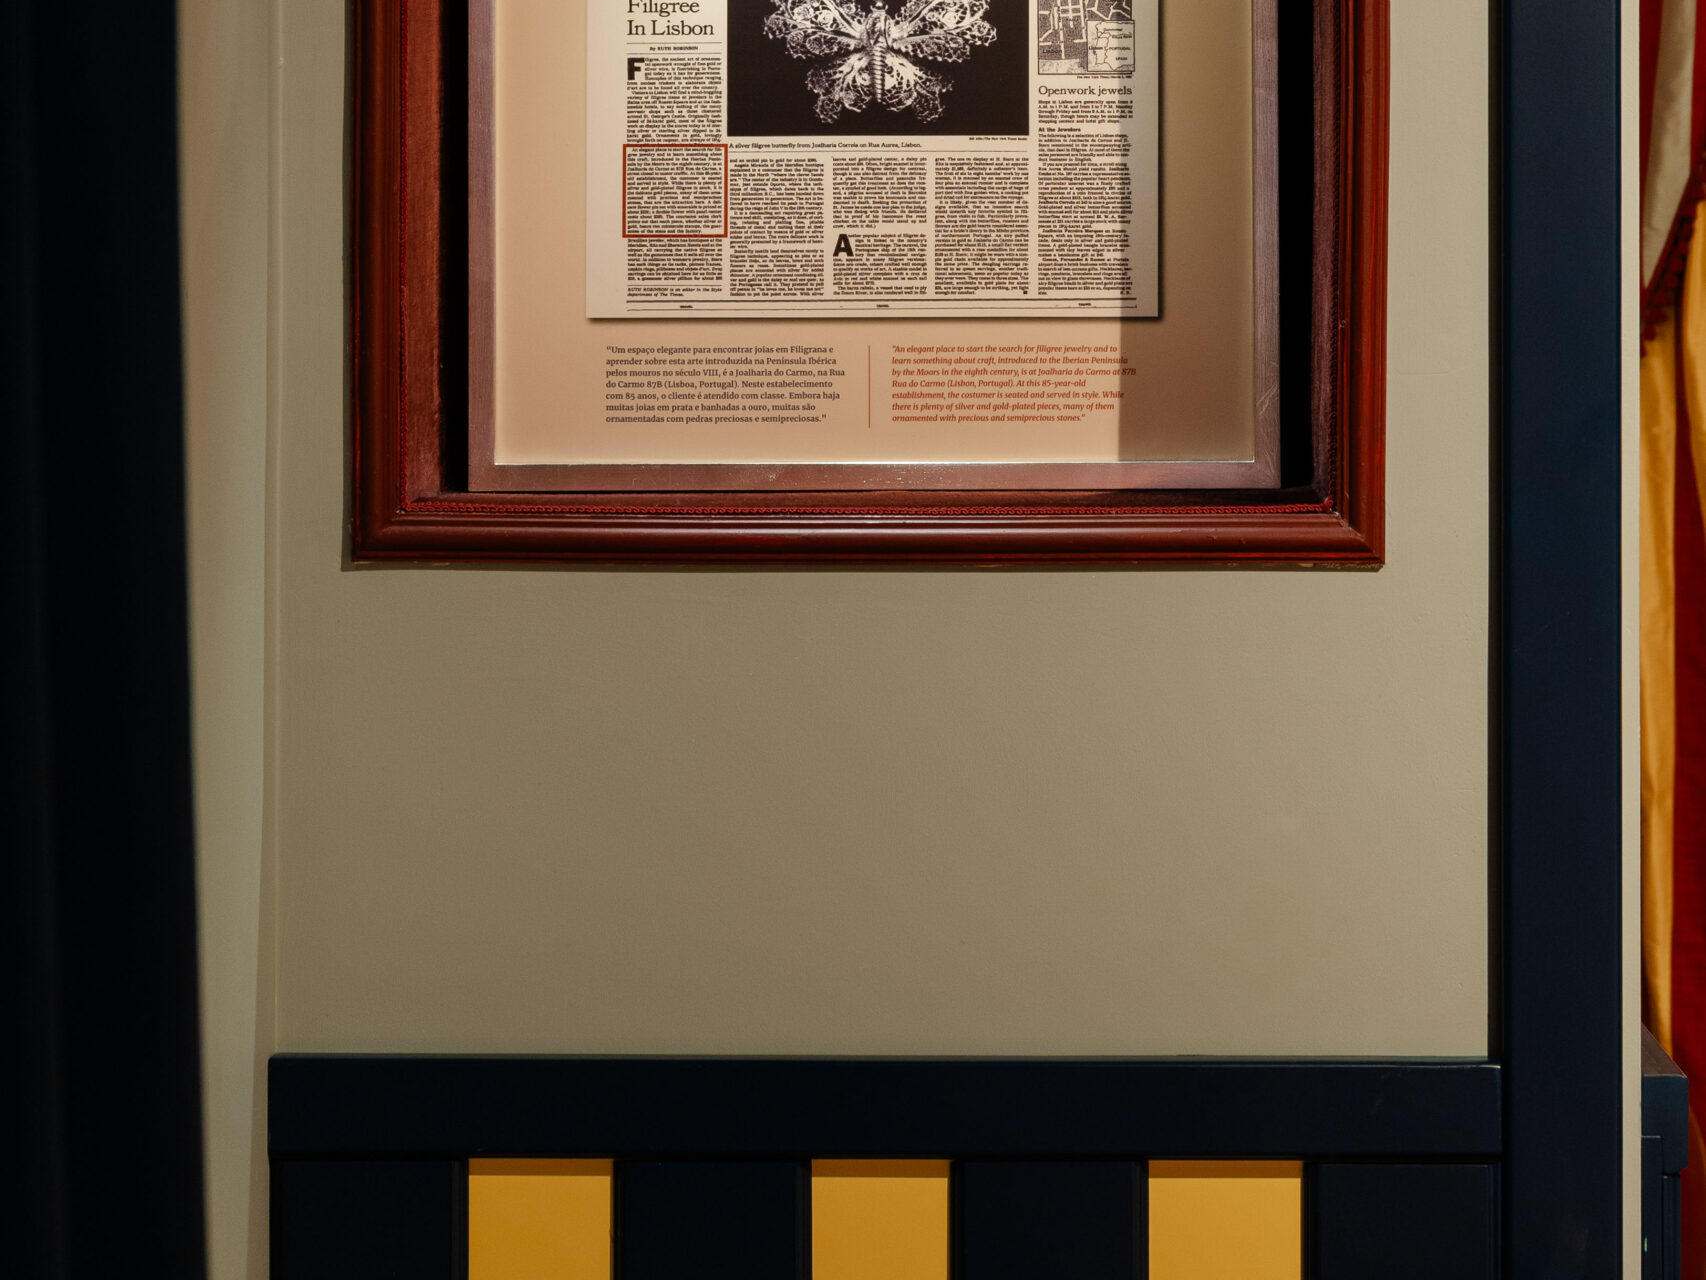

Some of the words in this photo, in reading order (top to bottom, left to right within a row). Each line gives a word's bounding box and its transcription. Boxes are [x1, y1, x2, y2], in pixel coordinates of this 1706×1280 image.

[627, 20, 646, 36] In
[650, 20, 714, 36] Lisbon
[1038, 86, 1096, 97] Openwork
[1098, 85, 1132, 97] jewels
[656, 346, 692, 356] elegante
[754, 345, 775, 355] joias
[790, 345, 828, 355] Filigrana
[906, 345, 934, 354] elegant
[936, 345, 955, 355] place
[1024, 345, 1035, 354] for
[1036, 345, 1062, 354] filigree
[1064, 345, 1092, 354] jewelry
[606, 357, 643, 367] aprender
[644, 357, 668, 365] sobre
[766, 356, 807, 365] Península
[808, 356, 837, 365] Ibérica
[892, 356, 912, 364] learn
[913, 356, 952, 366] something
[977, 356, 996, 366] craft,
[998, 356, 1038, 364] introduced
[1091, 356, 1128, 364] Peninsula
[606, 368, 628, 378] pelos
[674, 368, 701, 376] século
[702, 369, 721, 378] VIII,
[735, 368, 772, 378] Joalharia
[785, 369, 816, 378] Carmo,
[892, 368, 902, 378] by
[950, 368, 963, 376] the
[964, 367, 988, 377] eighth
[989, 369, 1020, 377] century,
[1038, 368, 1073, 376] Joalharia
[605, 380, 617, 388] do
[646, 380, 663, 389] 87B
[664, 380, 698, 390] (Lisboa,
[699, 380, 740, 390] Portugal).
[908, 379, 918, 388] do
[947, 379, 977, 388] (Lisbon,
[978, 379, 1015, 389] Portugal).
[1042, 379, 1086, 389] 85-year-old
[625, 392, 636, 400] 85
[703, 391, 740, 400] atendido
[822, 391, 840, 400] haja
[892, 391, 946, 400] establishment,
[1004, 390, 1029, 398] seated
[1030, 390, 1045, 399] and
[1046, 390, 1071, 399] served
[1081, 390, 1101, 400] style.
[1102, 390, 1124, 399] While
[635, 403, 656, 413] joias
[671, 404, 694, 413] prata
[700, 403, 740, 411] banhadas
[892, 402, 912, 410] there
[920, 402, 944, 412] plenty
[945, 402, 954, 412] of
[992, 402, 1036, 412] gold-plated
[1037, 402, 1062, 412] pieces,
[1086, 402, 1094, 412] of
[958, 414, 989, 423] precious
[990, 413, 1005, 422] and
[1006, 414, 1055, 423] semiprecious
